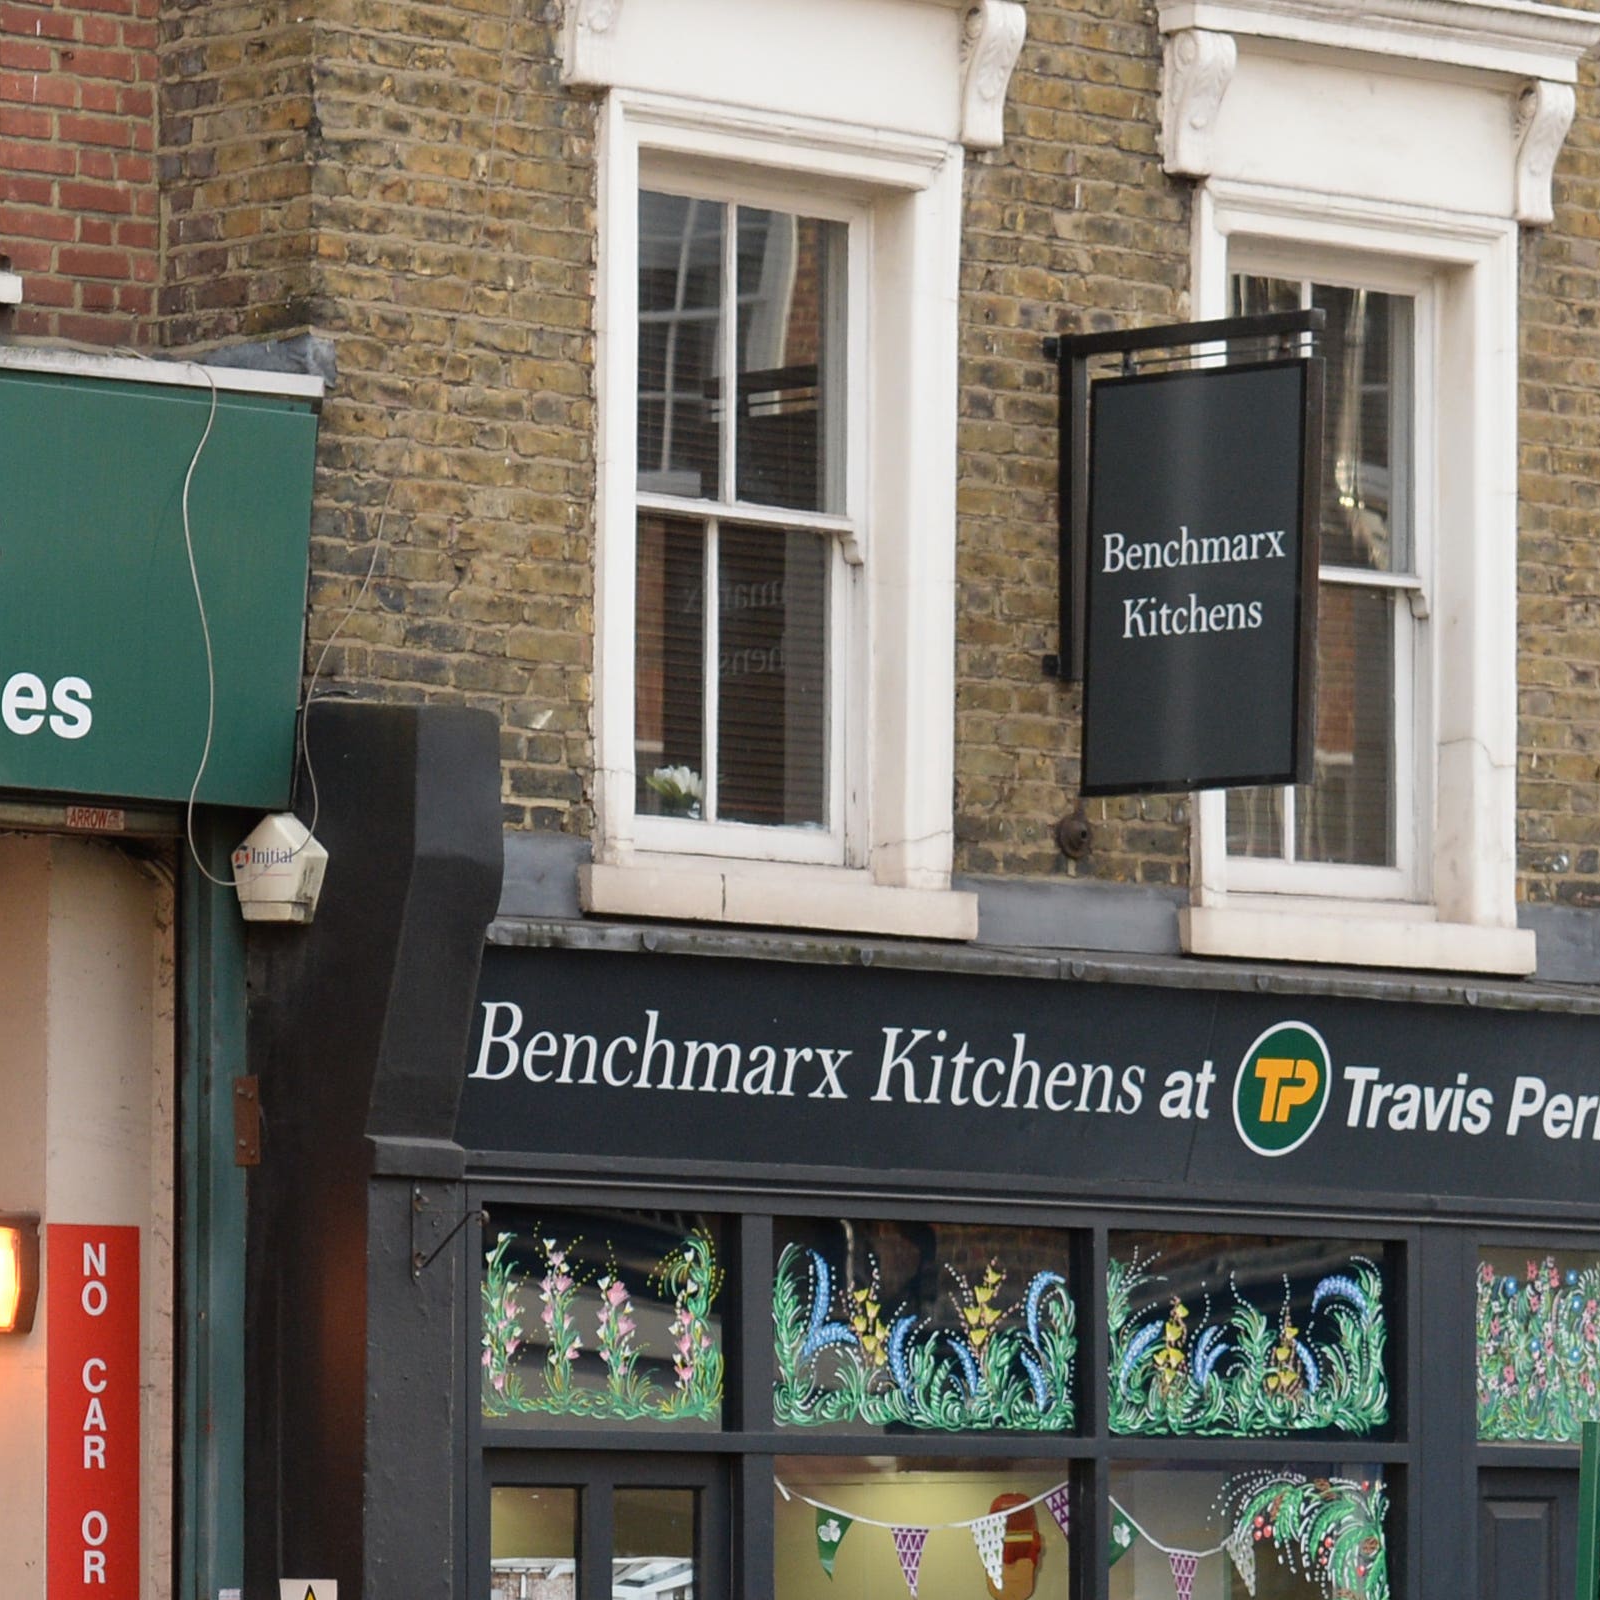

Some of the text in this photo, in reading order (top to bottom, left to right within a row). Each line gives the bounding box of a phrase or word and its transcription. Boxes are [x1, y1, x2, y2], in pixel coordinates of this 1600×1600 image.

[1102, 526, 1285, 573] Benchmarx
[1122, 594, 1263, 638] Kitchens
[468, 1001, 852, 1099] Benchmarx
[871, 1026, 1145, 1114] Kitchens
[1159, 1060, 1216, 1119] at
[1254, 1058, 1318, 1122] TP
[1343, 1066, 1493, 1135] Travis
[83, 1242, 106, 1316] NO
[83, 1359, 106, 1469] CAR
[83, 1510, 106, 1584] OR
